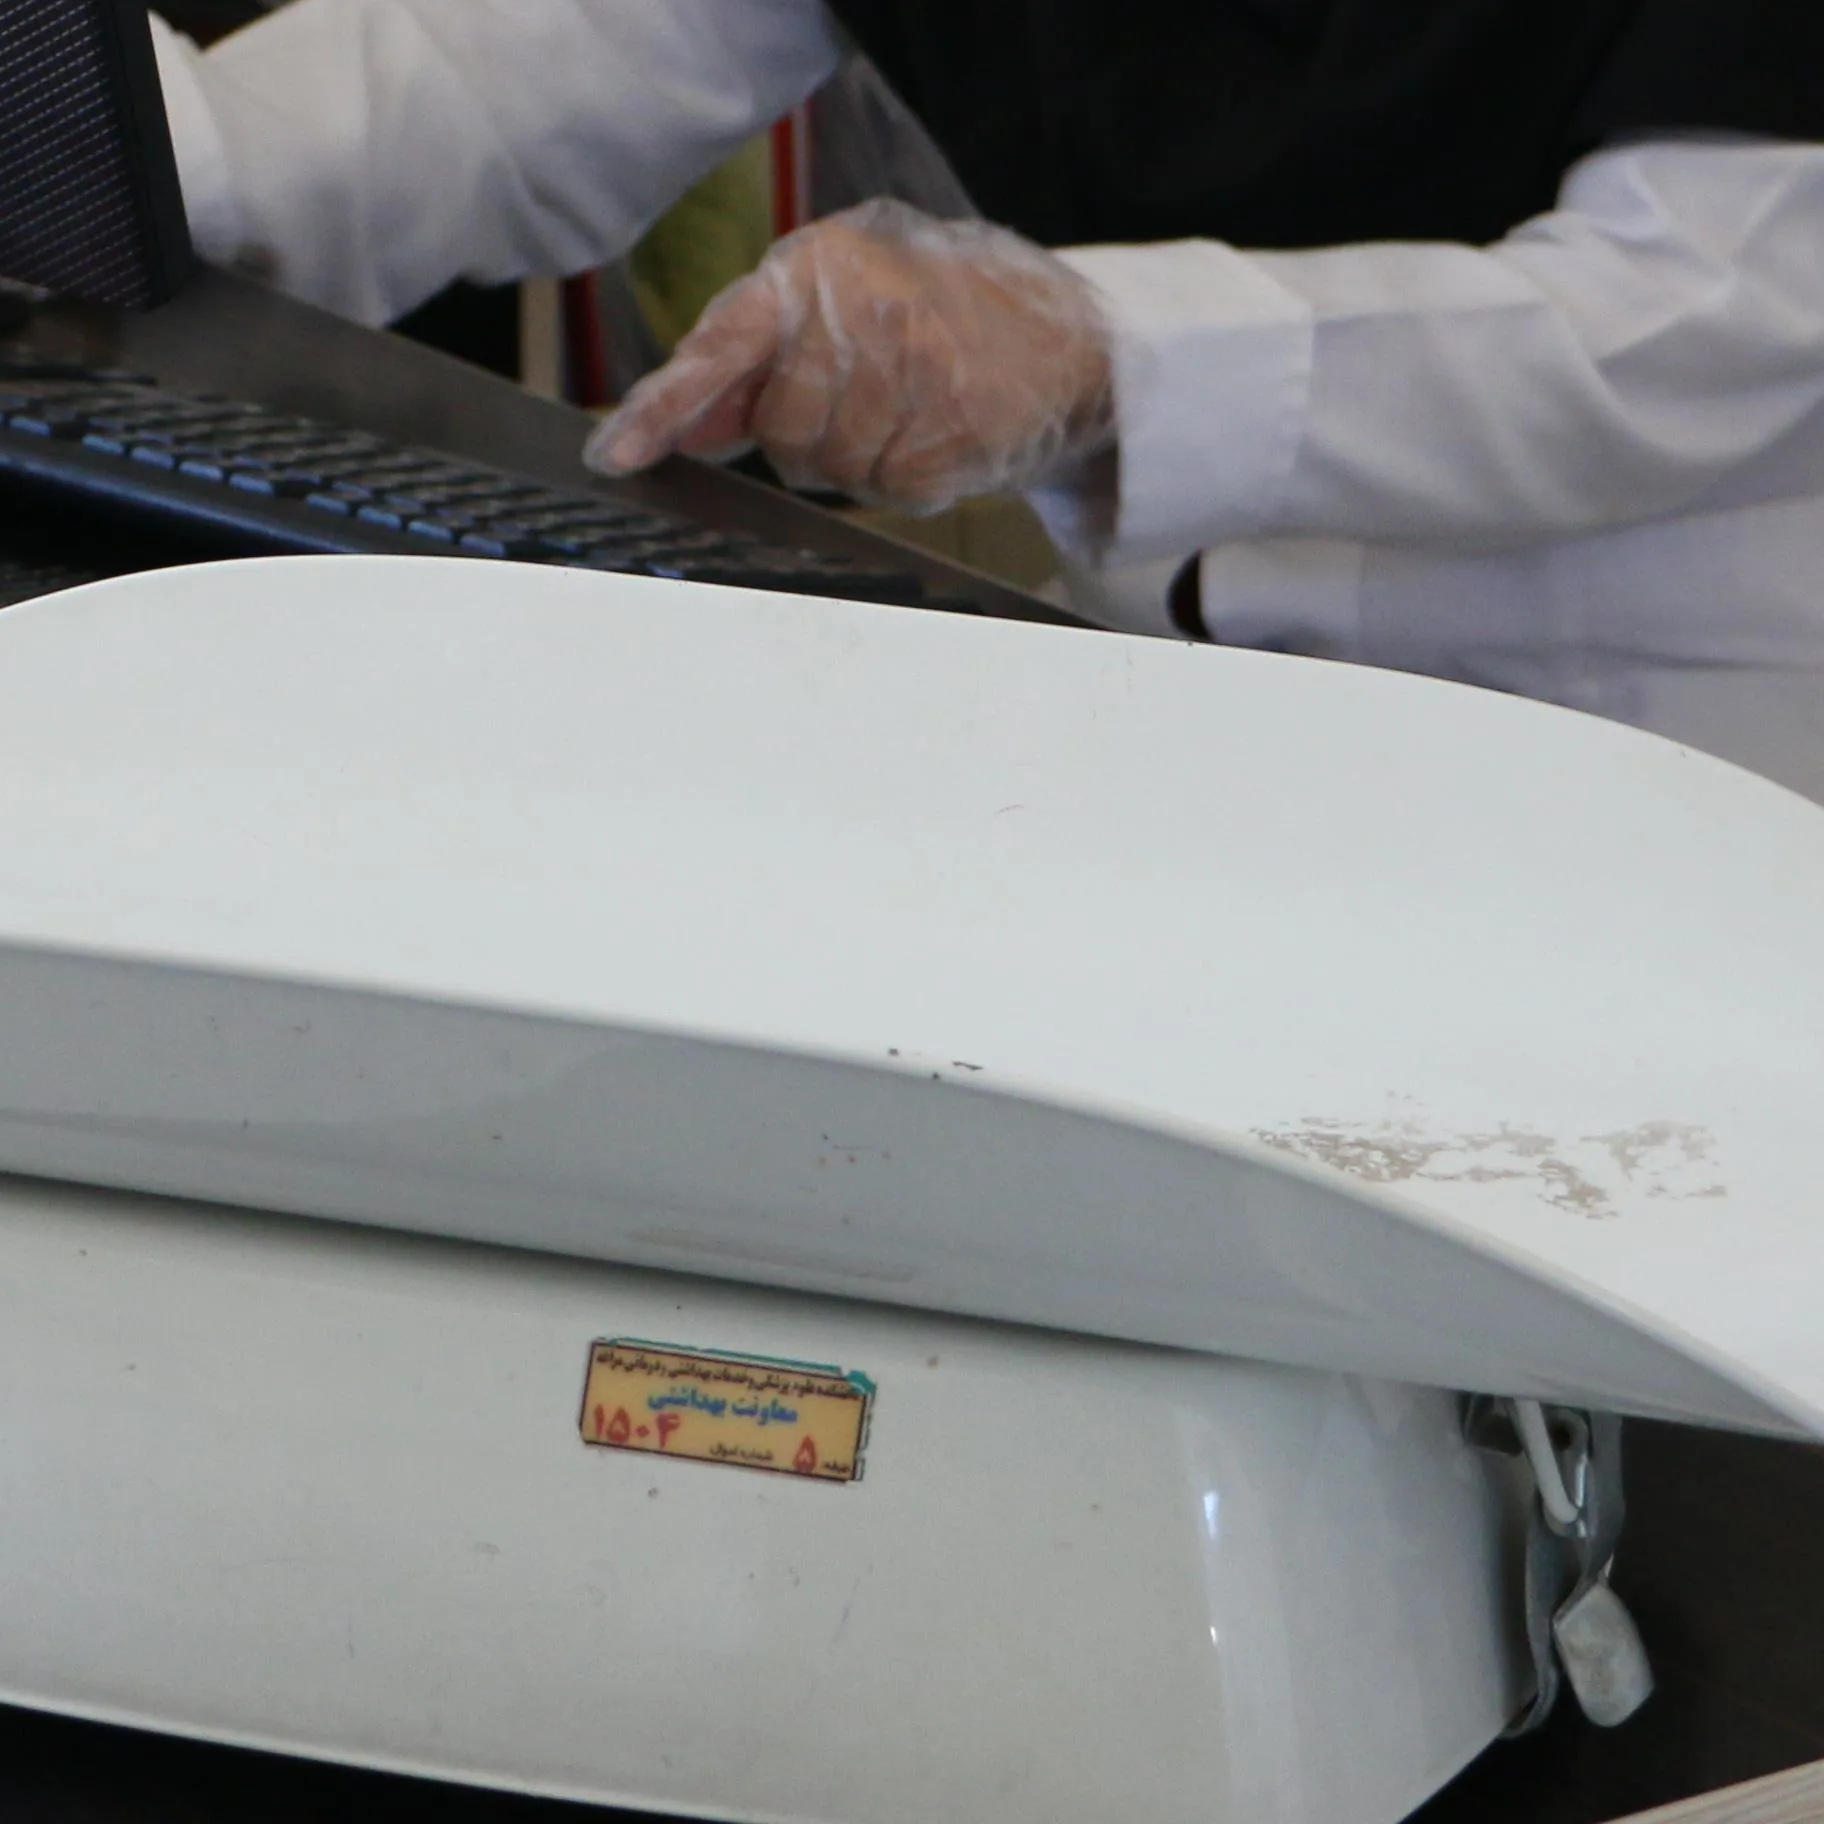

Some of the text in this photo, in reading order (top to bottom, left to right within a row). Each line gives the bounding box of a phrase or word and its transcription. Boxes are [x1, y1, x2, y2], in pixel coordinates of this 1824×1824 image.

[647, 1386, 798, 1427] معاونت بهداشتی
[792, 1434, 818, 1475] ۵
